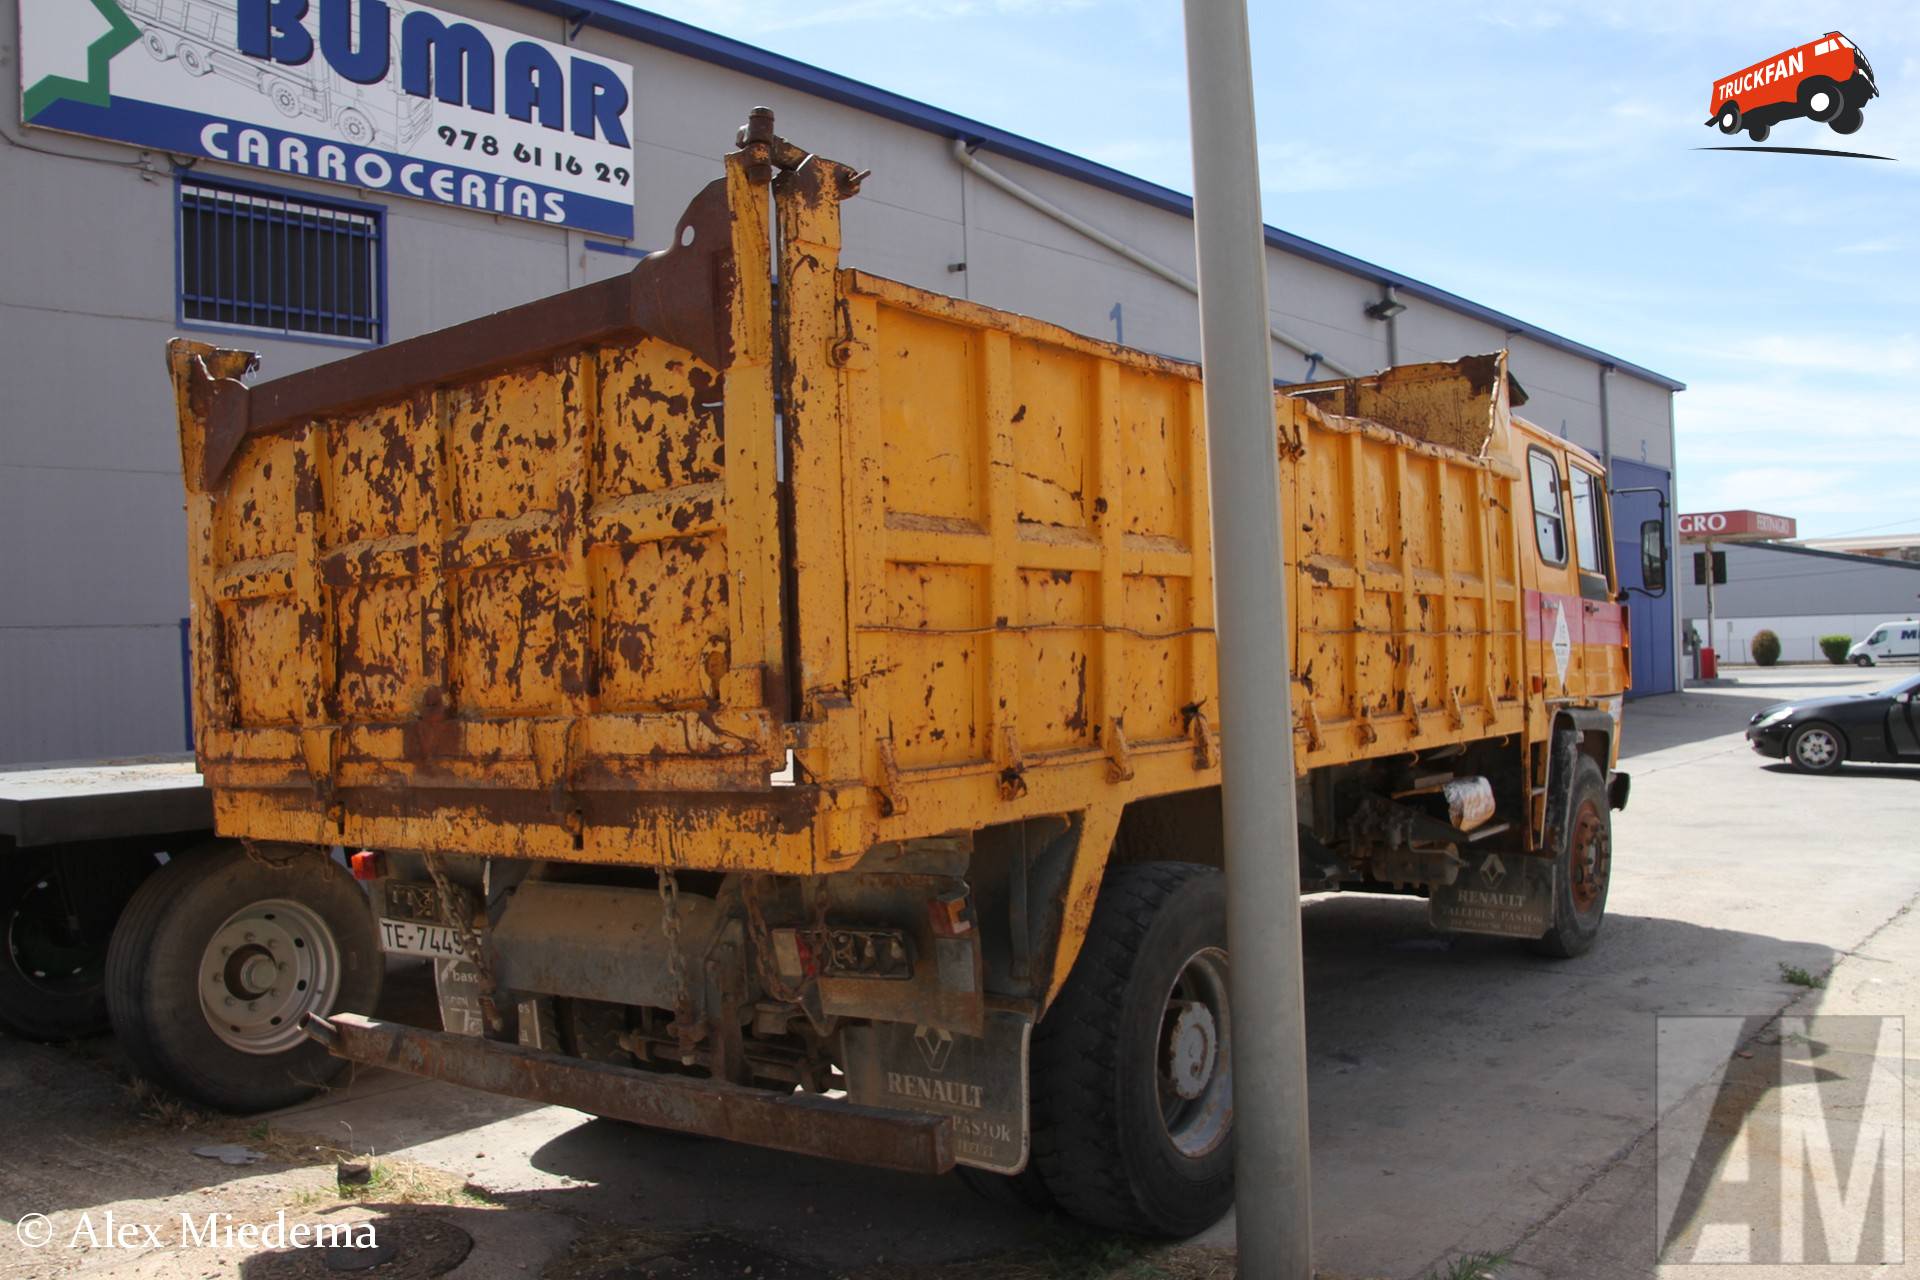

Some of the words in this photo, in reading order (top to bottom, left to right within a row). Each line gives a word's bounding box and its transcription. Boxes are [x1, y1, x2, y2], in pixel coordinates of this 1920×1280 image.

[237, 0, 631, 149] BUMAR
[200, 123, 566, 224] CARROCERÍAS
[437, 125, 499, 156] 978
[513, 142, 541, 167] 61
[555, 152, 583, 176] 16
[595, 162, 630, 187] 29
[1109, 302, 1123, 344] 1
[1901, 630, 1920, 640] M
[1457, 890, 1527, 908] RENAULT
[887, 1072, 984, 1108] RENAULT
